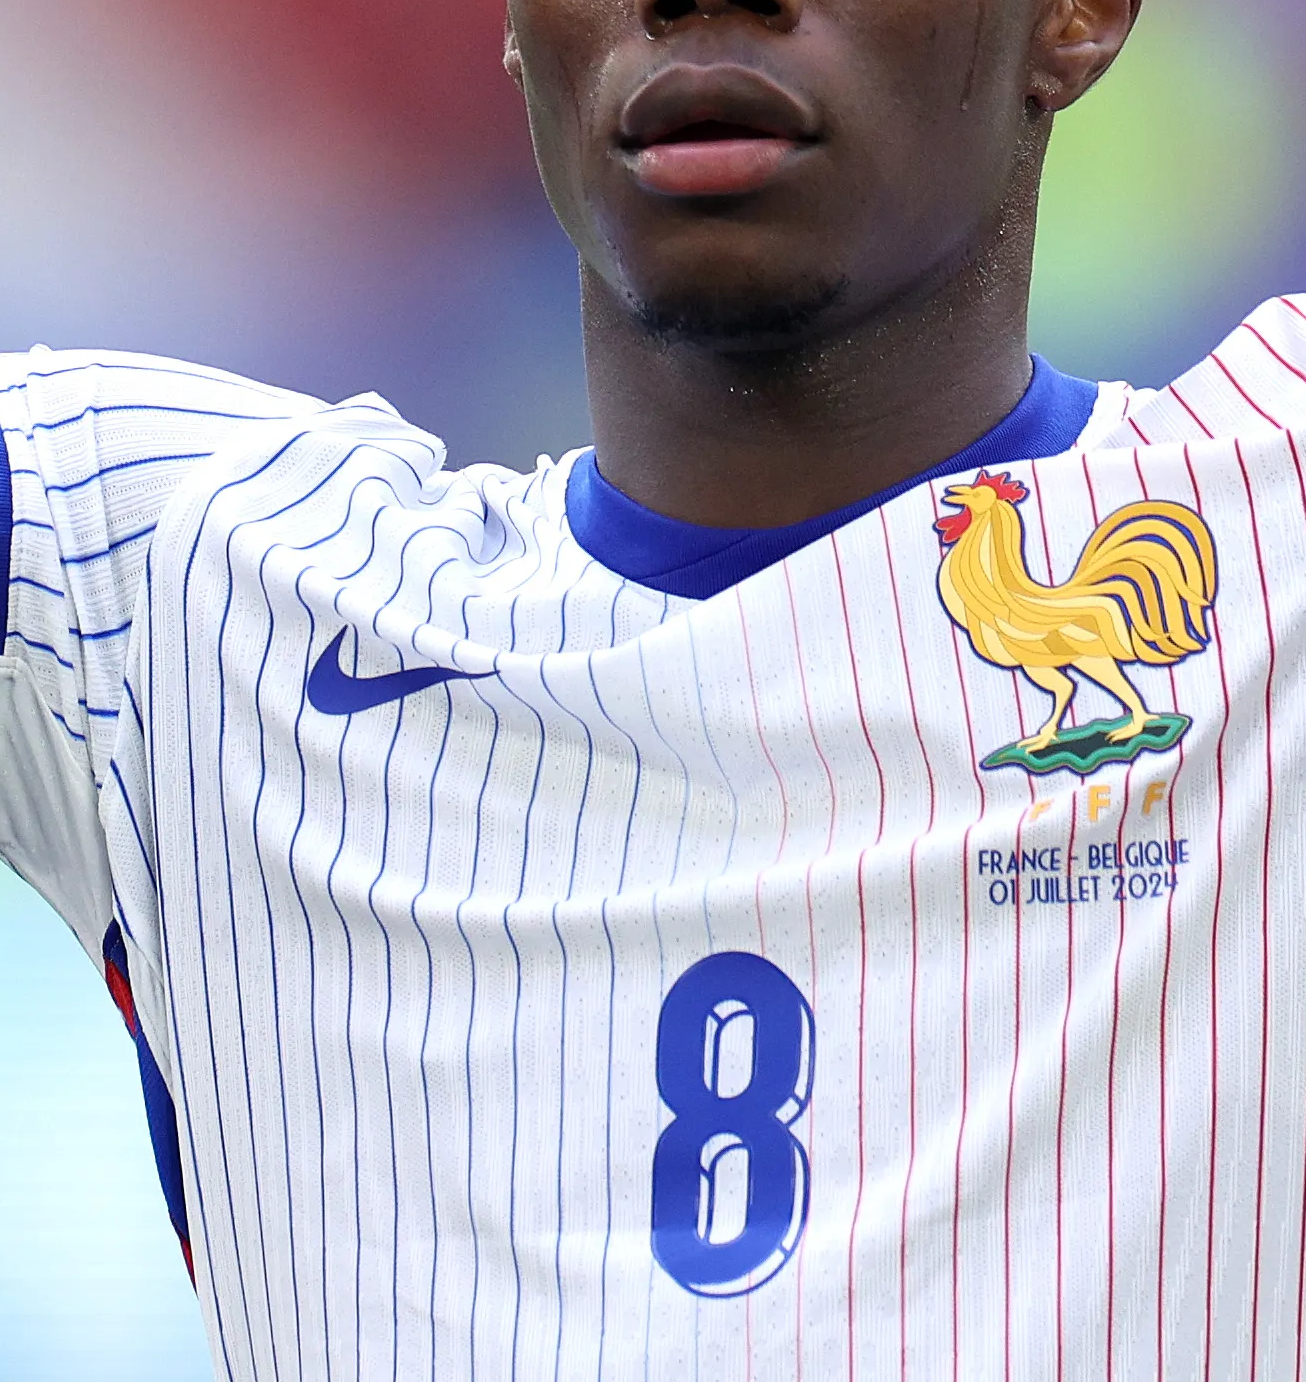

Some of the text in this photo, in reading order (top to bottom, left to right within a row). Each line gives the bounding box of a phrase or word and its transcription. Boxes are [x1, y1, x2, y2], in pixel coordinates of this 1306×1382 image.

[1088, 785, 1111, 822] F
[1142, 781, 1167, 815] F
[978, 847, 1061, 875] FRANCE
[1088, 838, 1190, 870] BELGIQUE
[989, 872, 1179, 906] 01 JUILLET 2024
[651, 951, 816, 1298] 8
